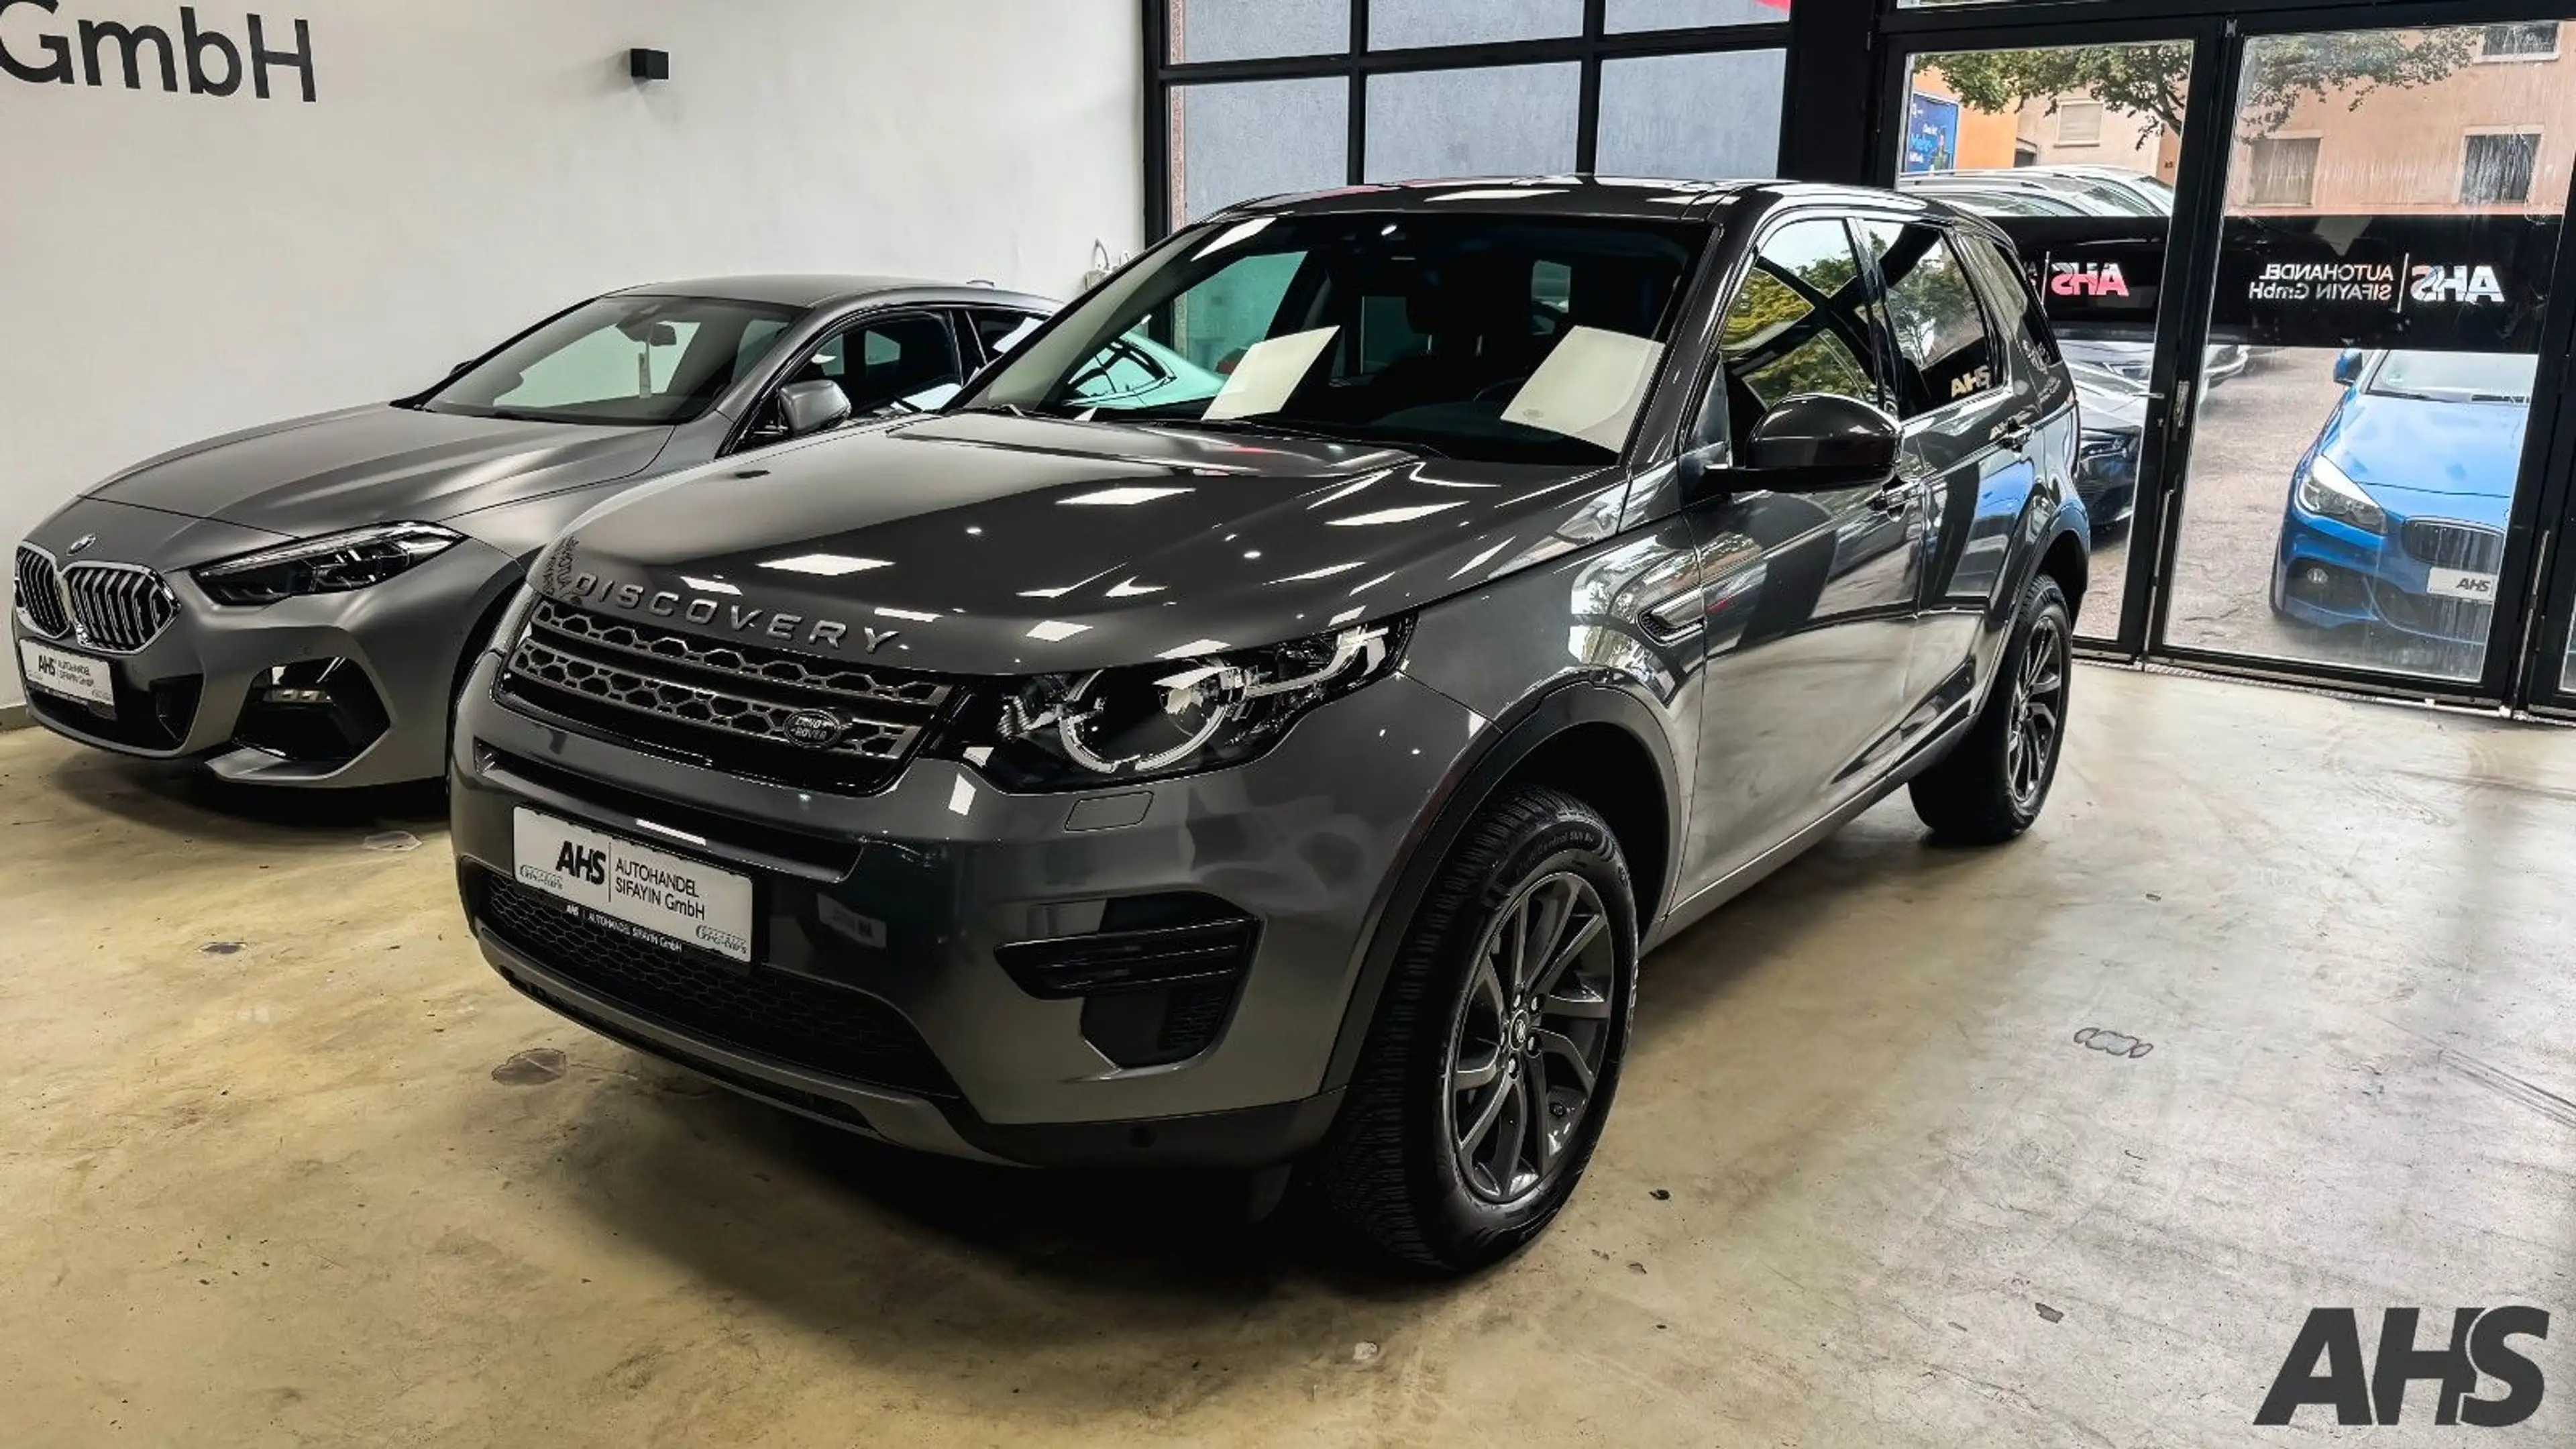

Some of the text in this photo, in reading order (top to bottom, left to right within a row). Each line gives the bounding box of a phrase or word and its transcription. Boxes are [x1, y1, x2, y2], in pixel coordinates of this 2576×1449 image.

[0, 0, 316, 102] GmbH
[2456, 578, 2491, 592] AHS
[572, 572, 900, 655] DISCOVERY
[38, 655, 56, 676] AHS
[555, 841, 606, 885] AHS
[615, 858, 700, 898] AUTOHANDEL
[615, 877, 705, 920] SIFAYIN GmbH
